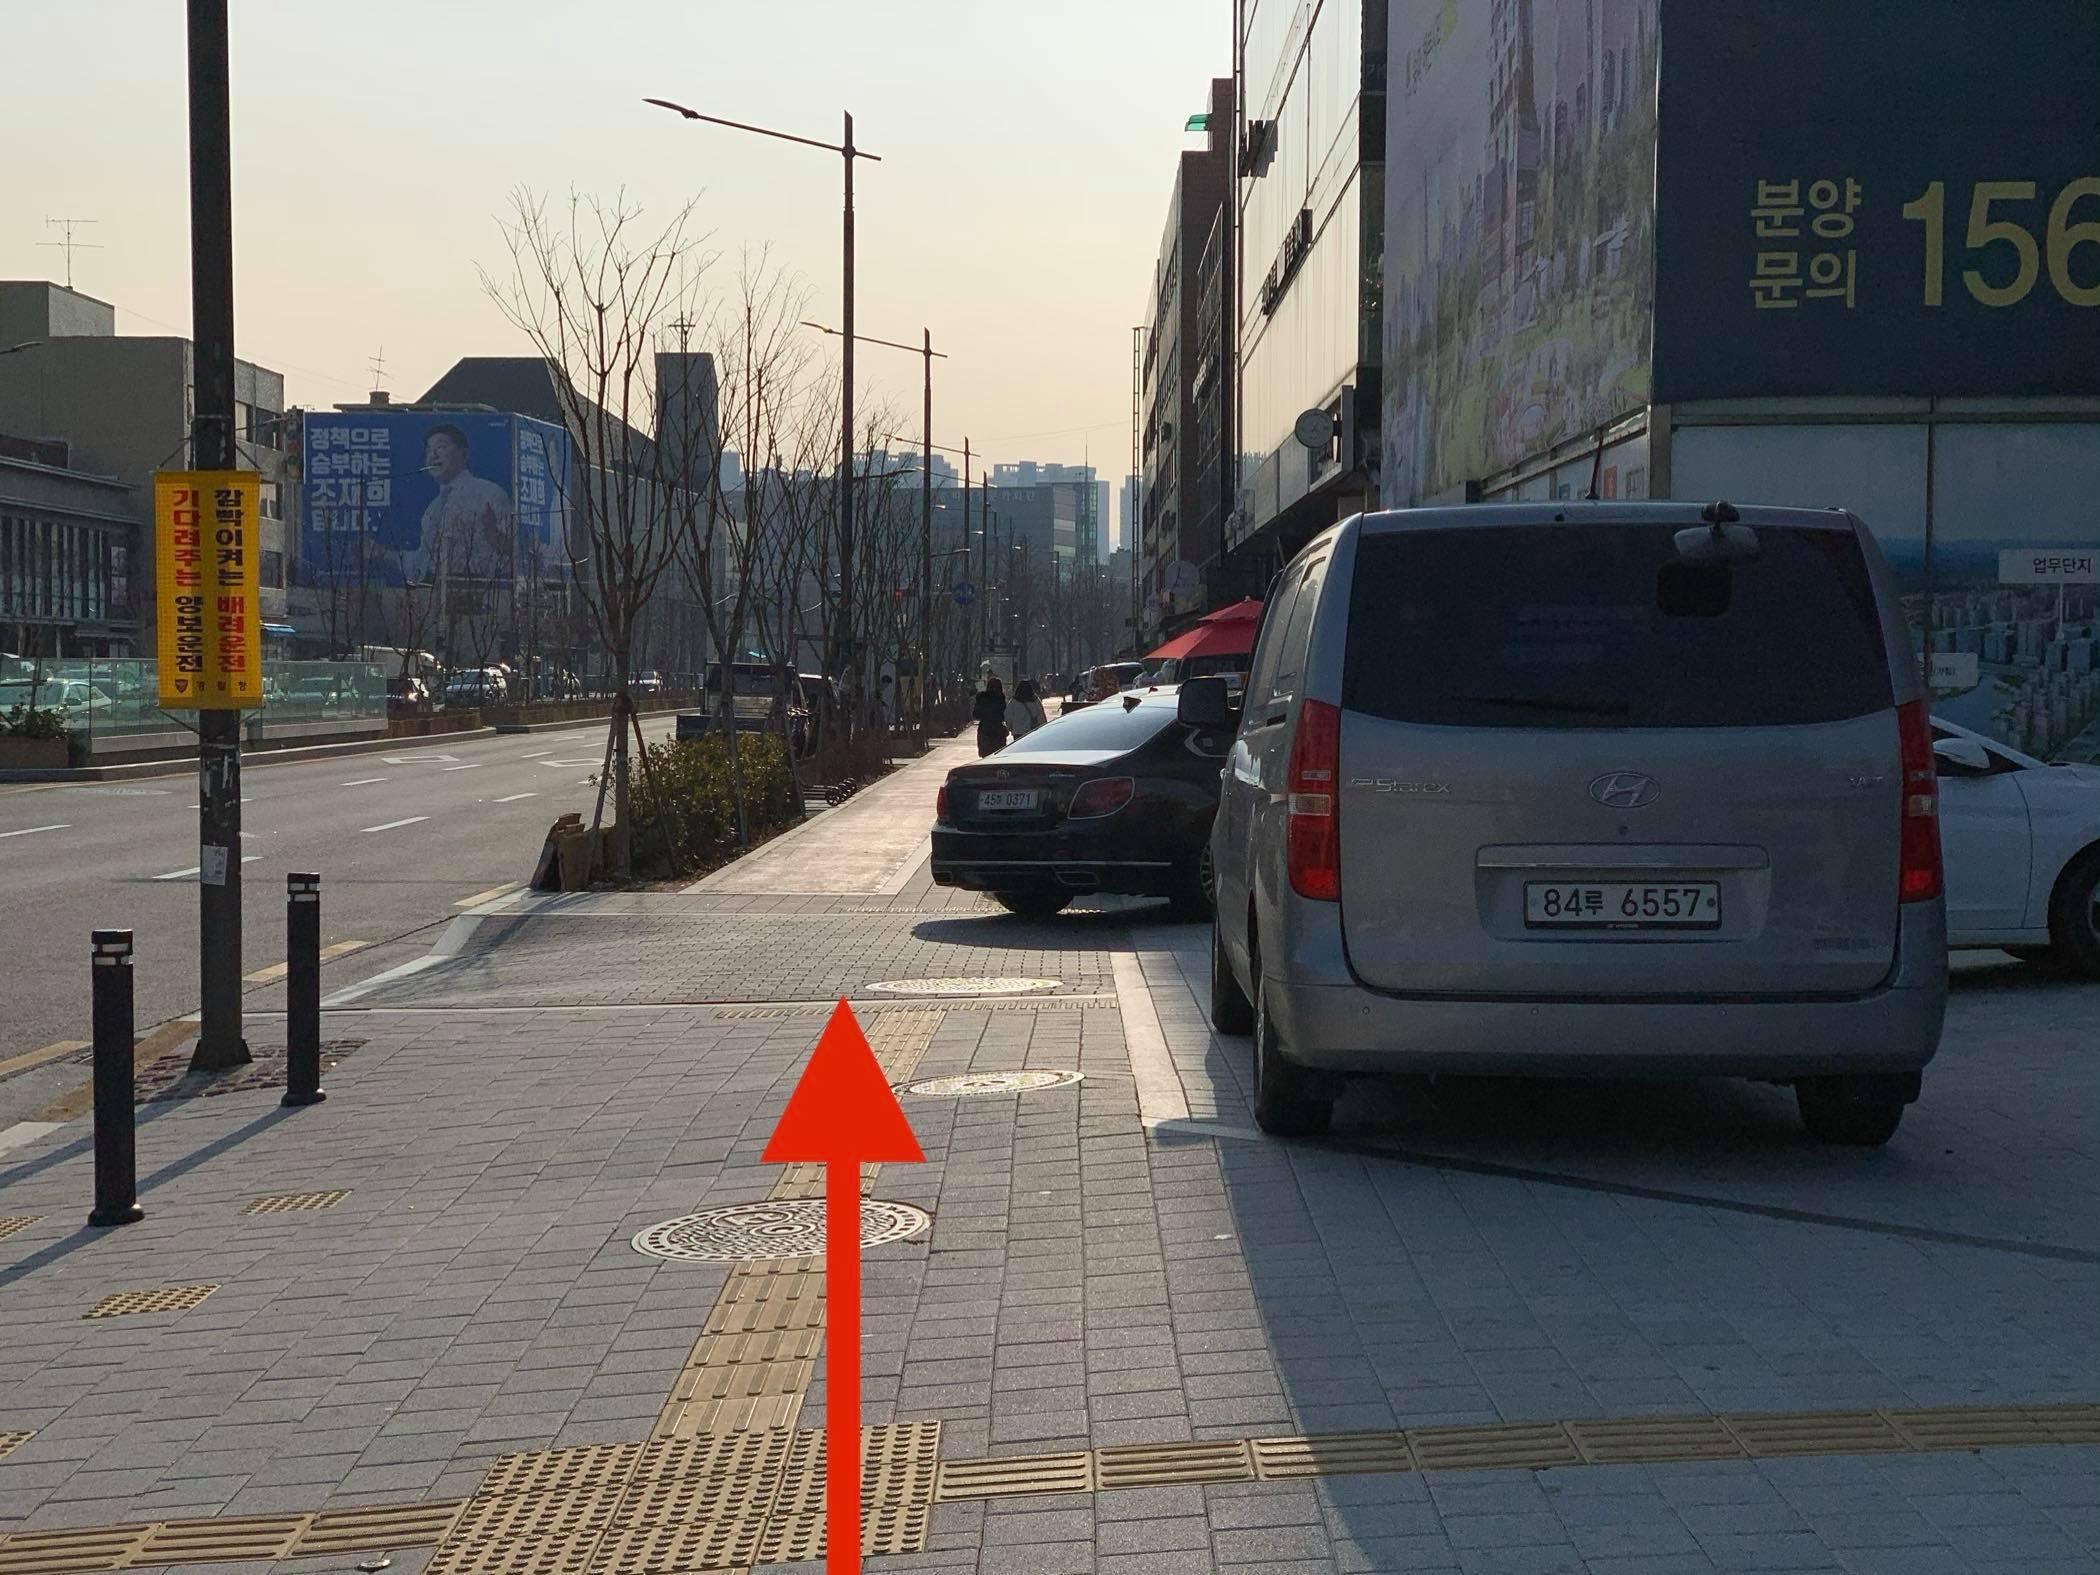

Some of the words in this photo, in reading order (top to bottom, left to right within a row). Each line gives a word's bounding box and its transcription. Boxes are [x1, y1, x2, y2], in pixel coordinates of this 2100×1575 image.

[1751, 177, 1863, 238] 분양
[1902, 176, 2100, 308] 156
[1749, 249, 1857, 309] 문의
[310, 427, 391, 450] 정책으로
[311, 452, 391, 475] 승부하는
[311, 477, 391, 507] 조재희
[173, 489, 202, 586] 기다려주는
[212, 488, 244, 587] 깜빡이켜는
[2033, 557, 2092, 576] 업무단지
[175, 595, 204, 672] 양보운전
[217, 595, 246, 672] 배려운전
[1543, 887, 1604, 917] 84루
[1621, 887, 1701, 917] 6557
